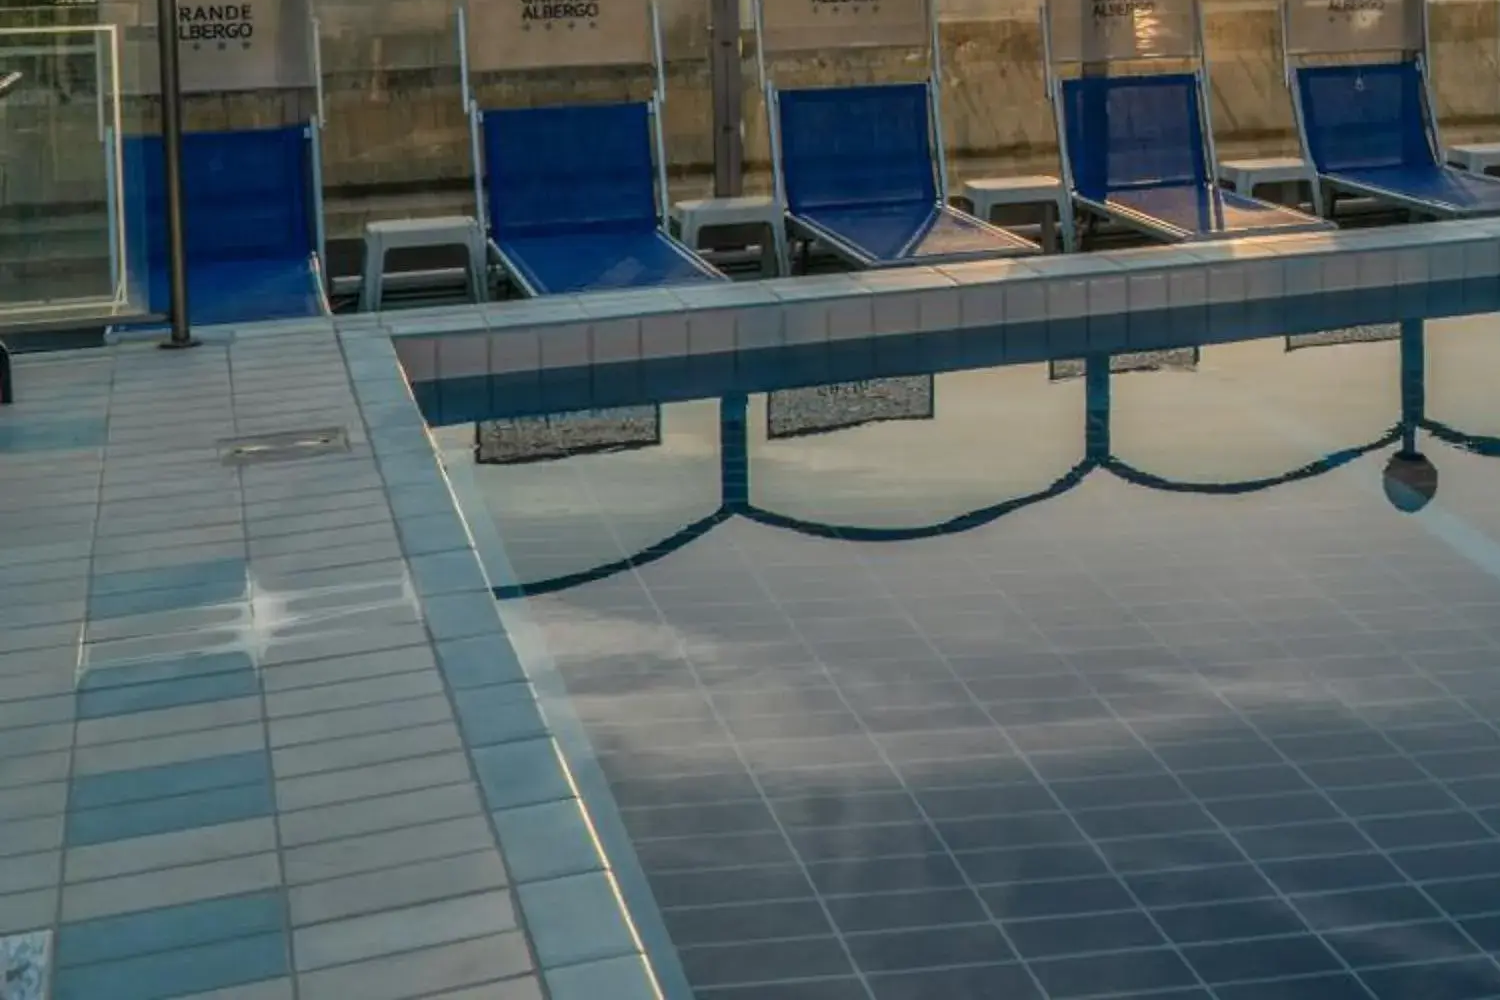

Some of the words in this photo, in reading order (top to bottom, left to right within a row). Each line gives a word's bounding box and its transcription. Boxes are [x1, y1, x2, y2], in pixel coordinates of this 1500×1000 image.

[179, 4, 253, 21] RANDE
[522, 3, 600, 20] ALBERGO
[179, 23, 253, 40] LBERGO
